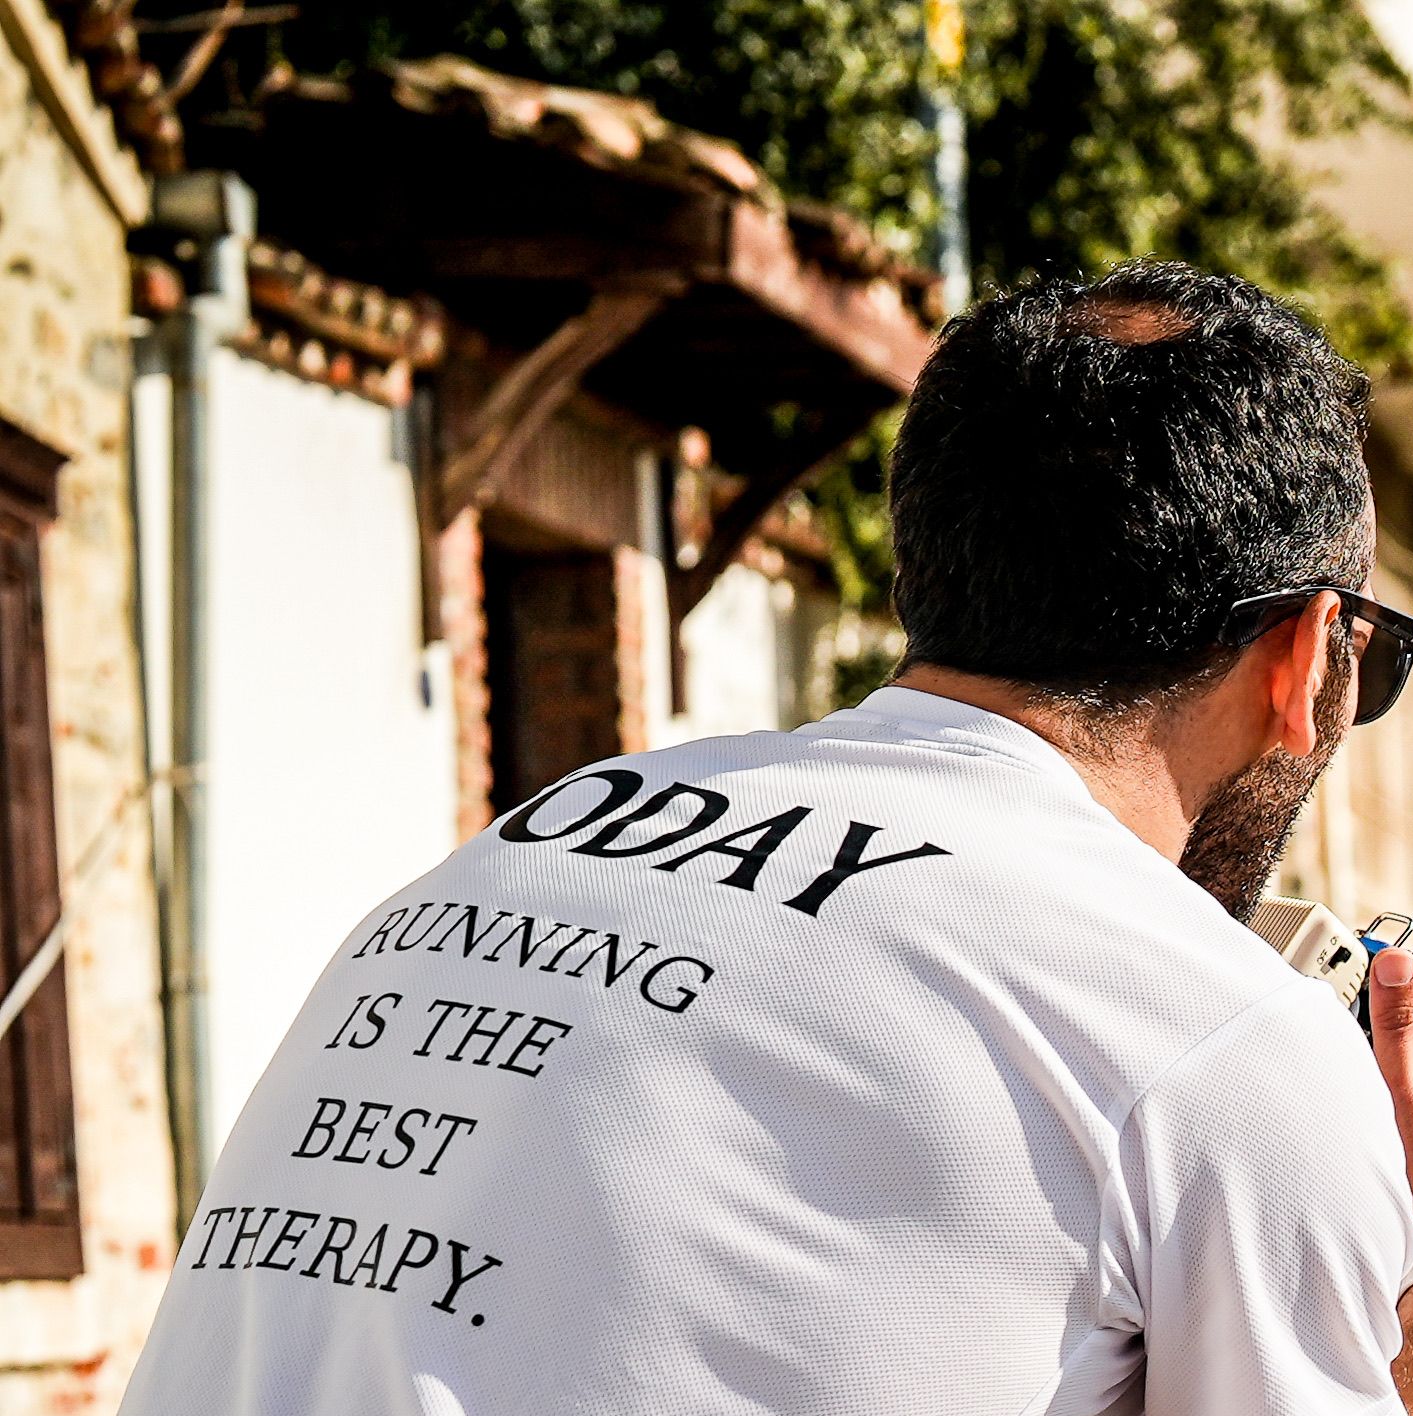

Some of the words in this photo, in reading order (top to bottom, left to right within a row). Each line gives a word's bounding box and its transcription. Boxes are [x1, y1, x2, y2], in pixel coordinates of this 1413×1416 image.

[499, 770, 952, 918] ODAY
[352, 903, 714, 1013] RUNNING
[325, 993, 403, 1049] IS
[413, 999, 573, 1078] THE
[291, 1098, 478, 1175] BEST
[192, 1207, 503, 1326] THERAPY.
